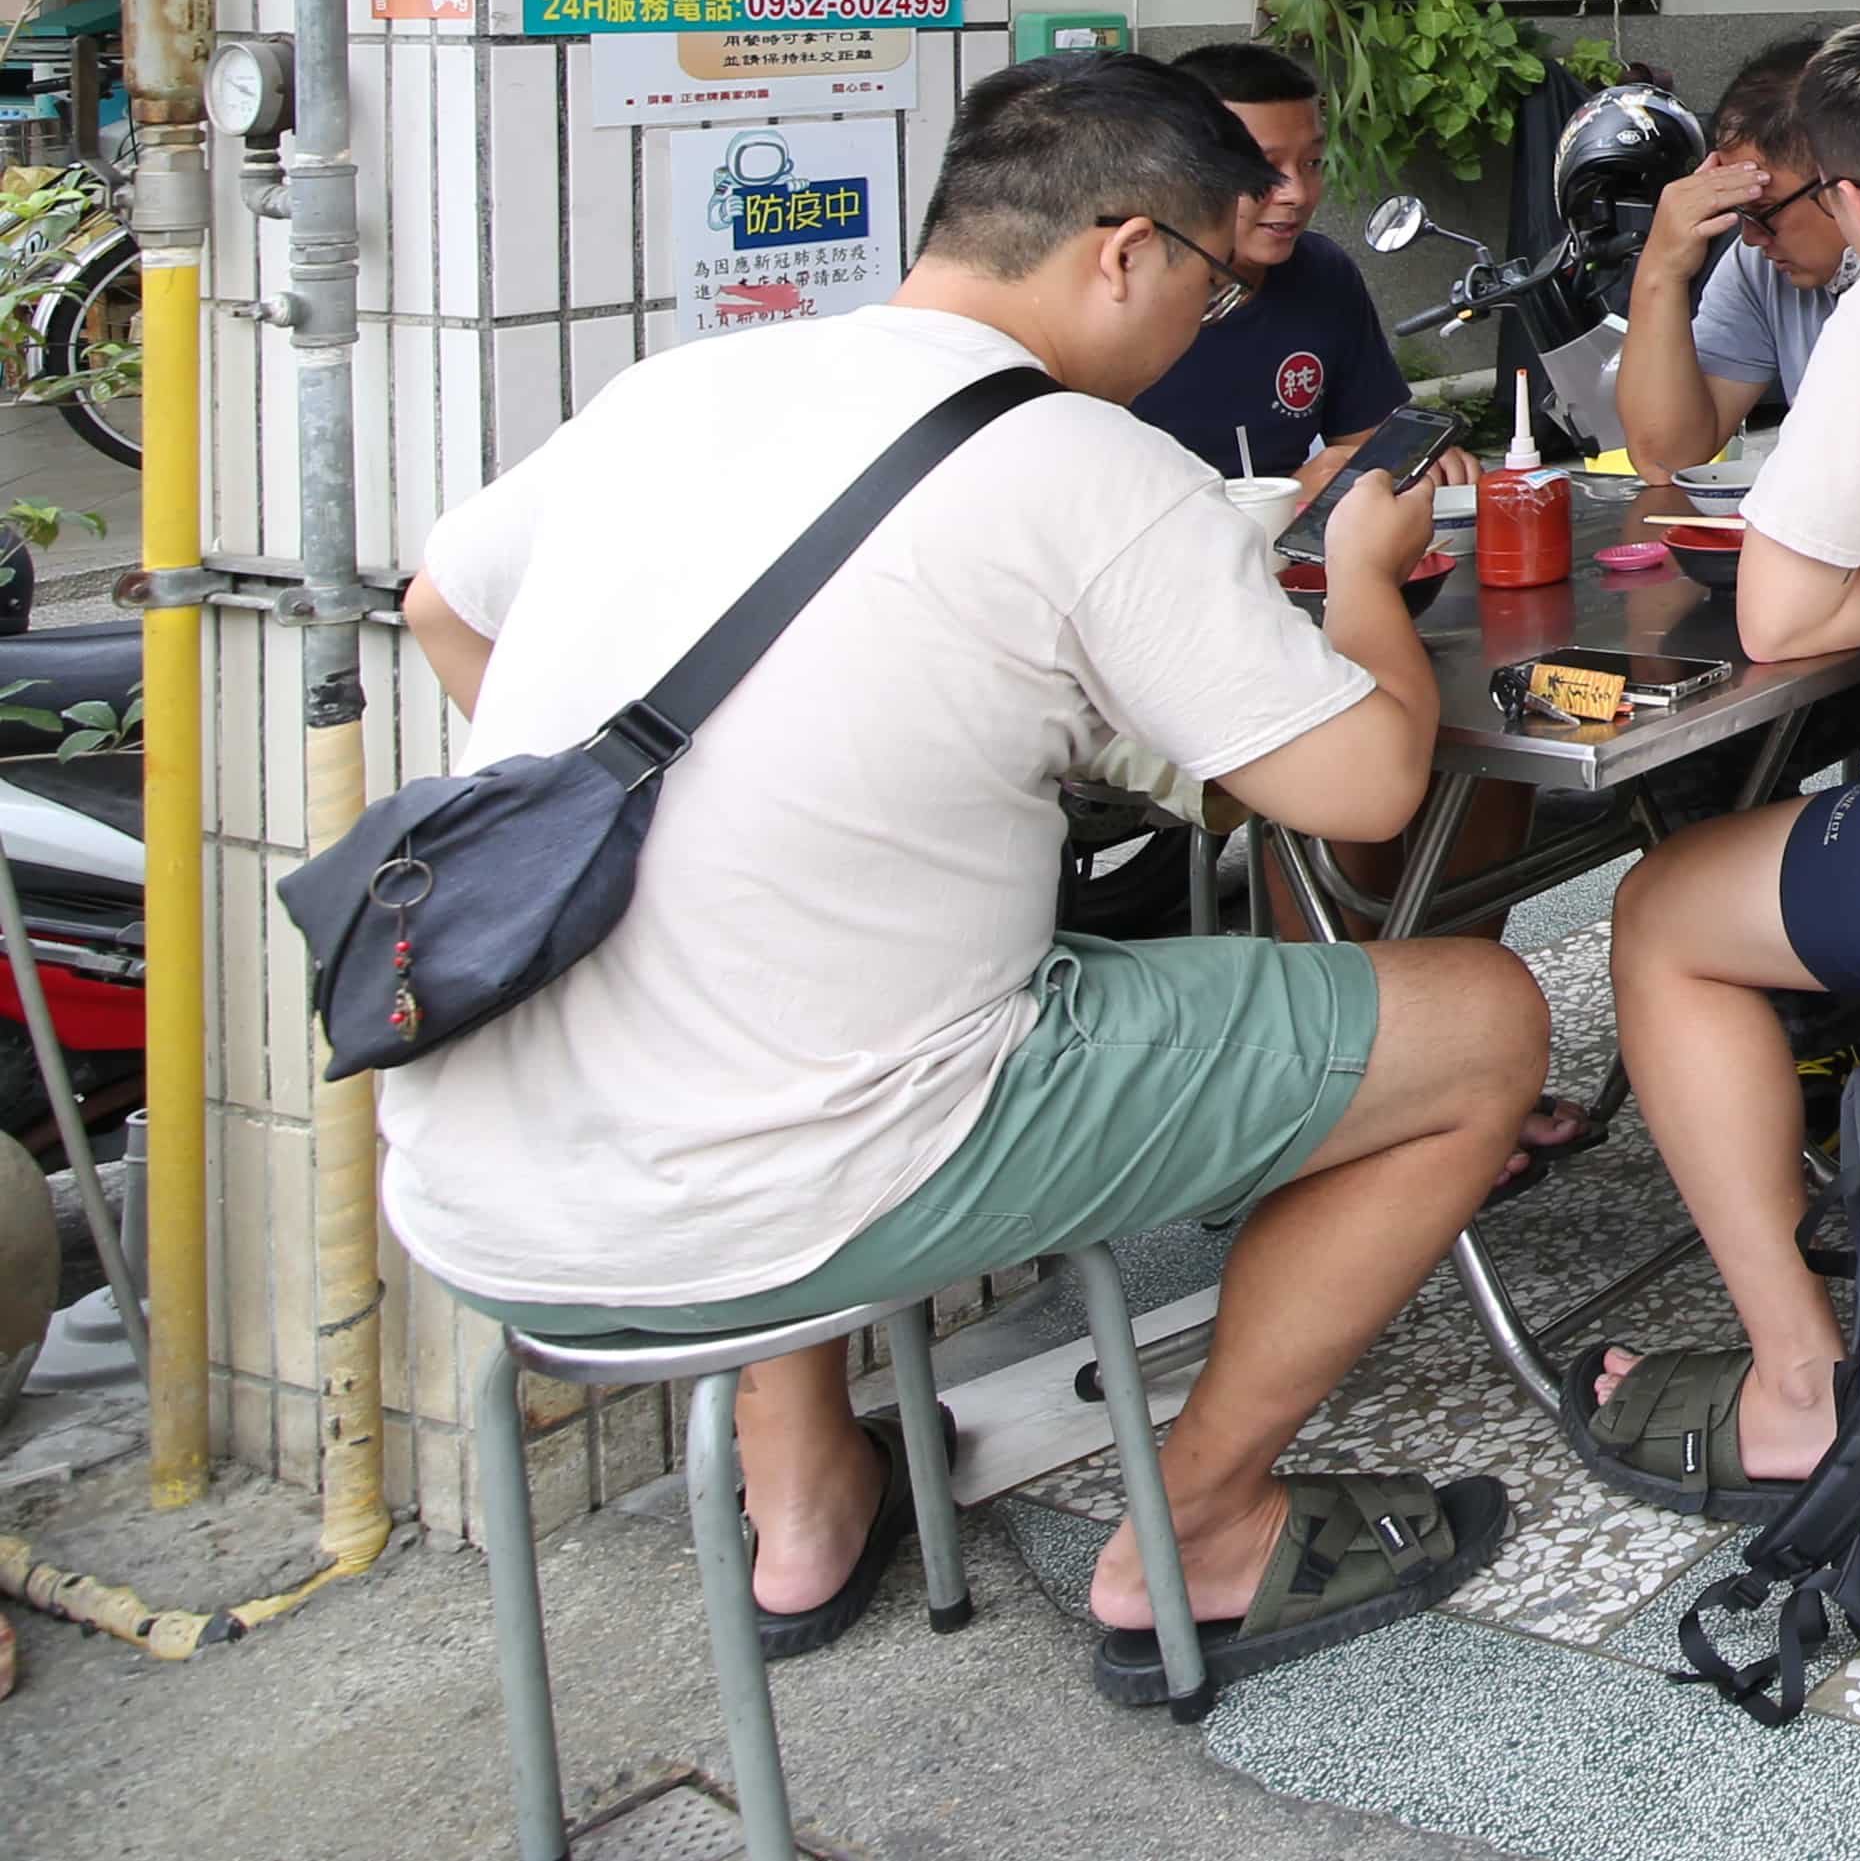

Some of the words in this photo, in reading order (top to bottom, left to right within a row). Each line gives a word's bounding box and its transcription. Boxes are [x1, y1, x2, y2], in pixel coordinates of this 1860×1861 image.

[722, 49, 873, 68] 並請保持社交距離
[745, 186, 862, 236] 防疫中
